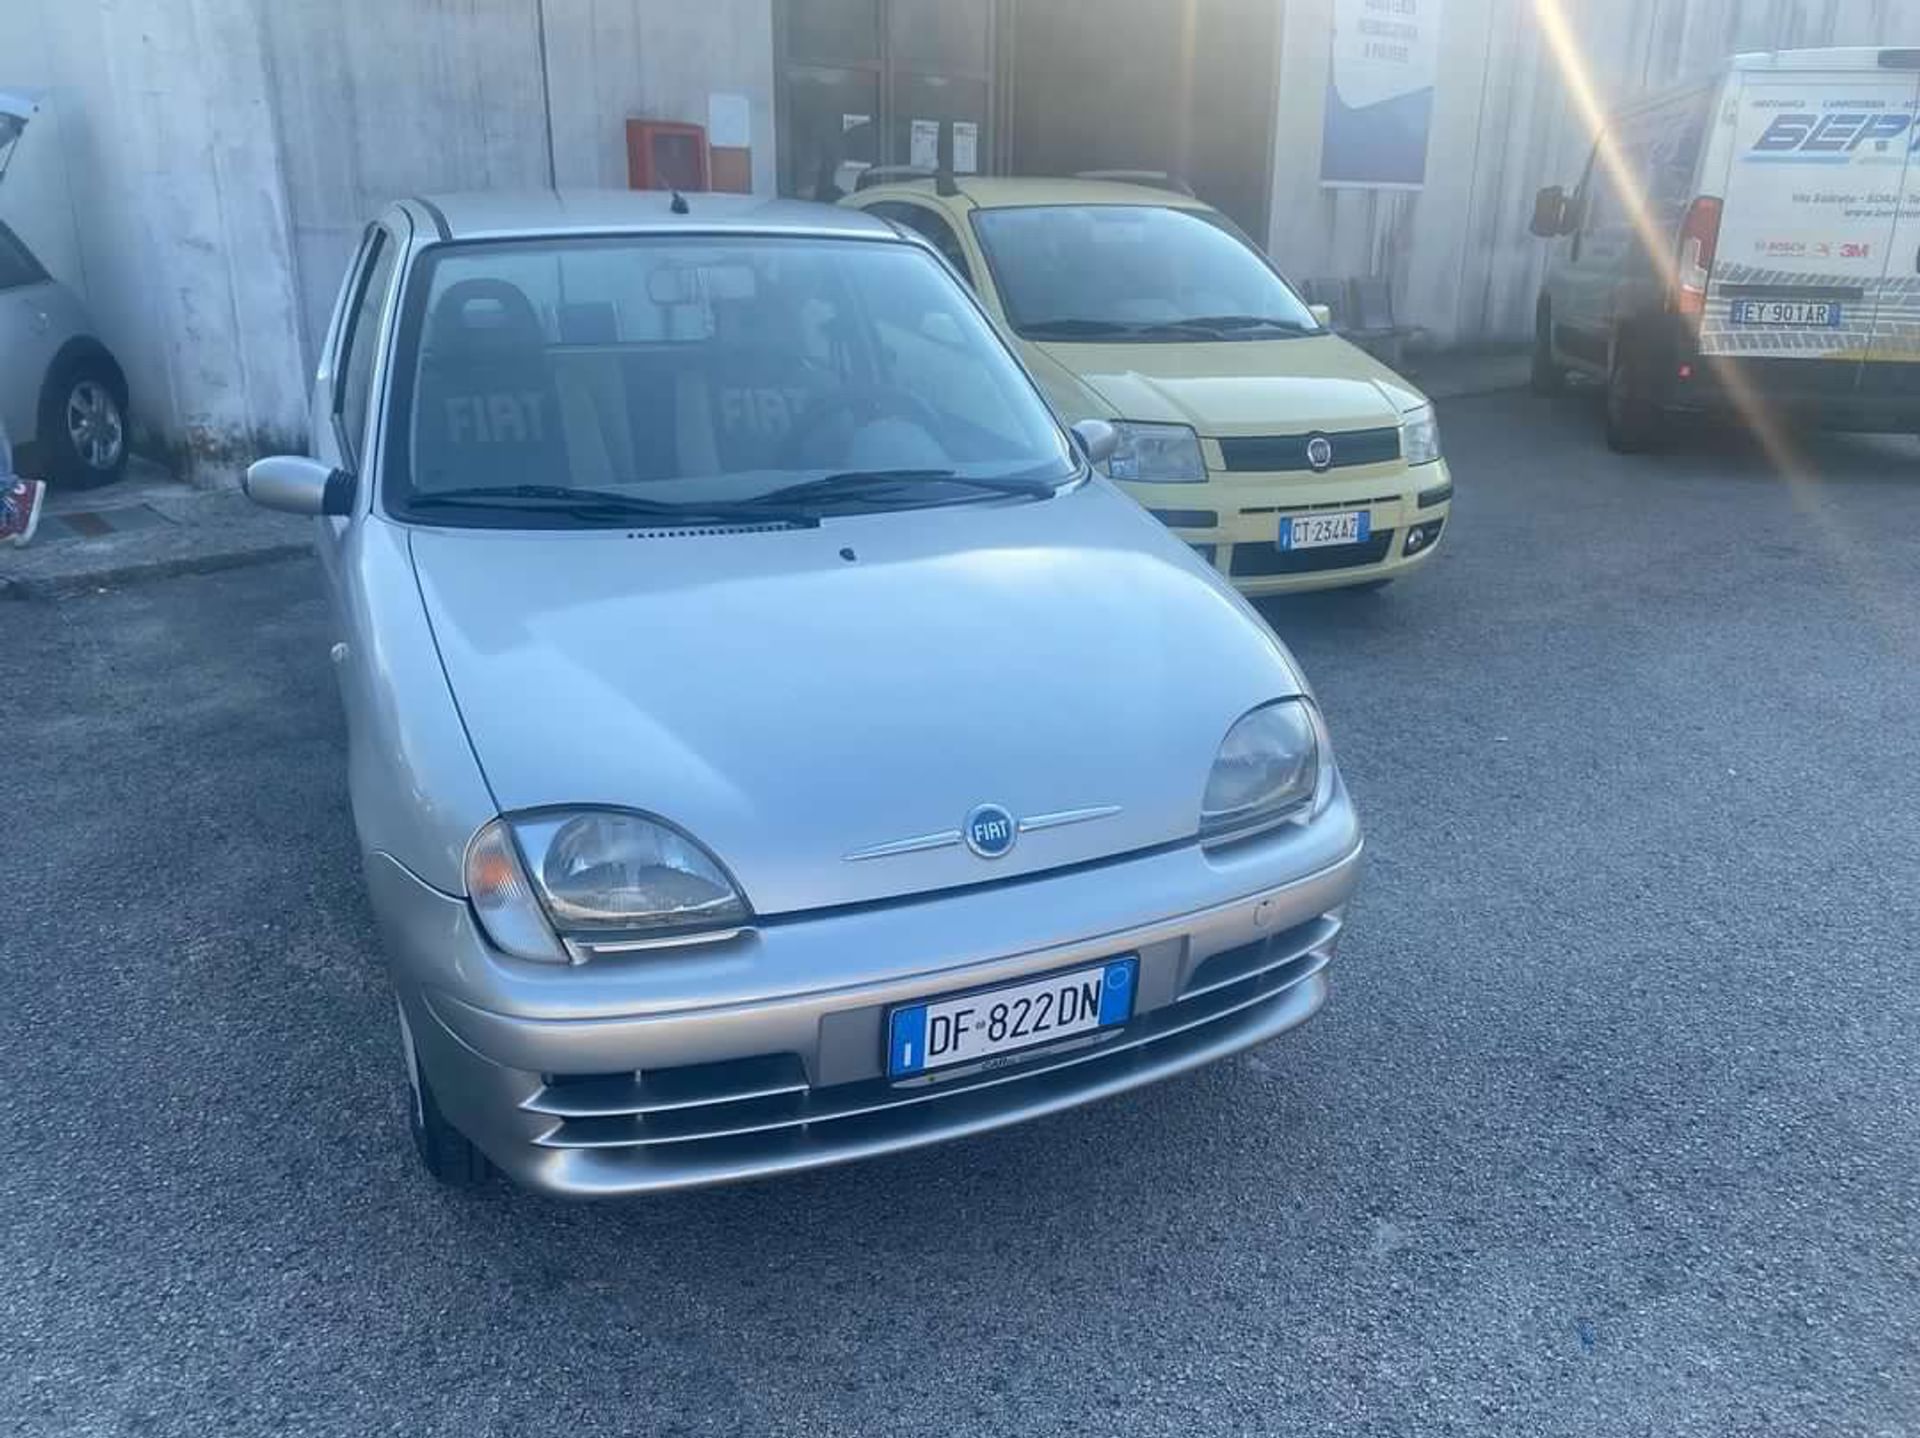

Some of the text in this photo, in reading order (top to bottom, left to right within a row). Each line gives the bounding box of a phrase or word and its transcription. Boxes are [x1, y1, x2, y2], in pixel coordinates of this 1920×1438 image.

[1839, 243, 1869, 257] 3M
[1745, 304, 1826, 324] EY 901AR
[444, 393, 544, 443] FIAT
[721, 387, 808, 434] FIAT
[1292, 517, 1356, 543] CT 234AZ
[973, 820, 1008, 842] FIAT
[929, 1009, 975, 1056] DF
[987, 979, 1102, 1043] 822DN
